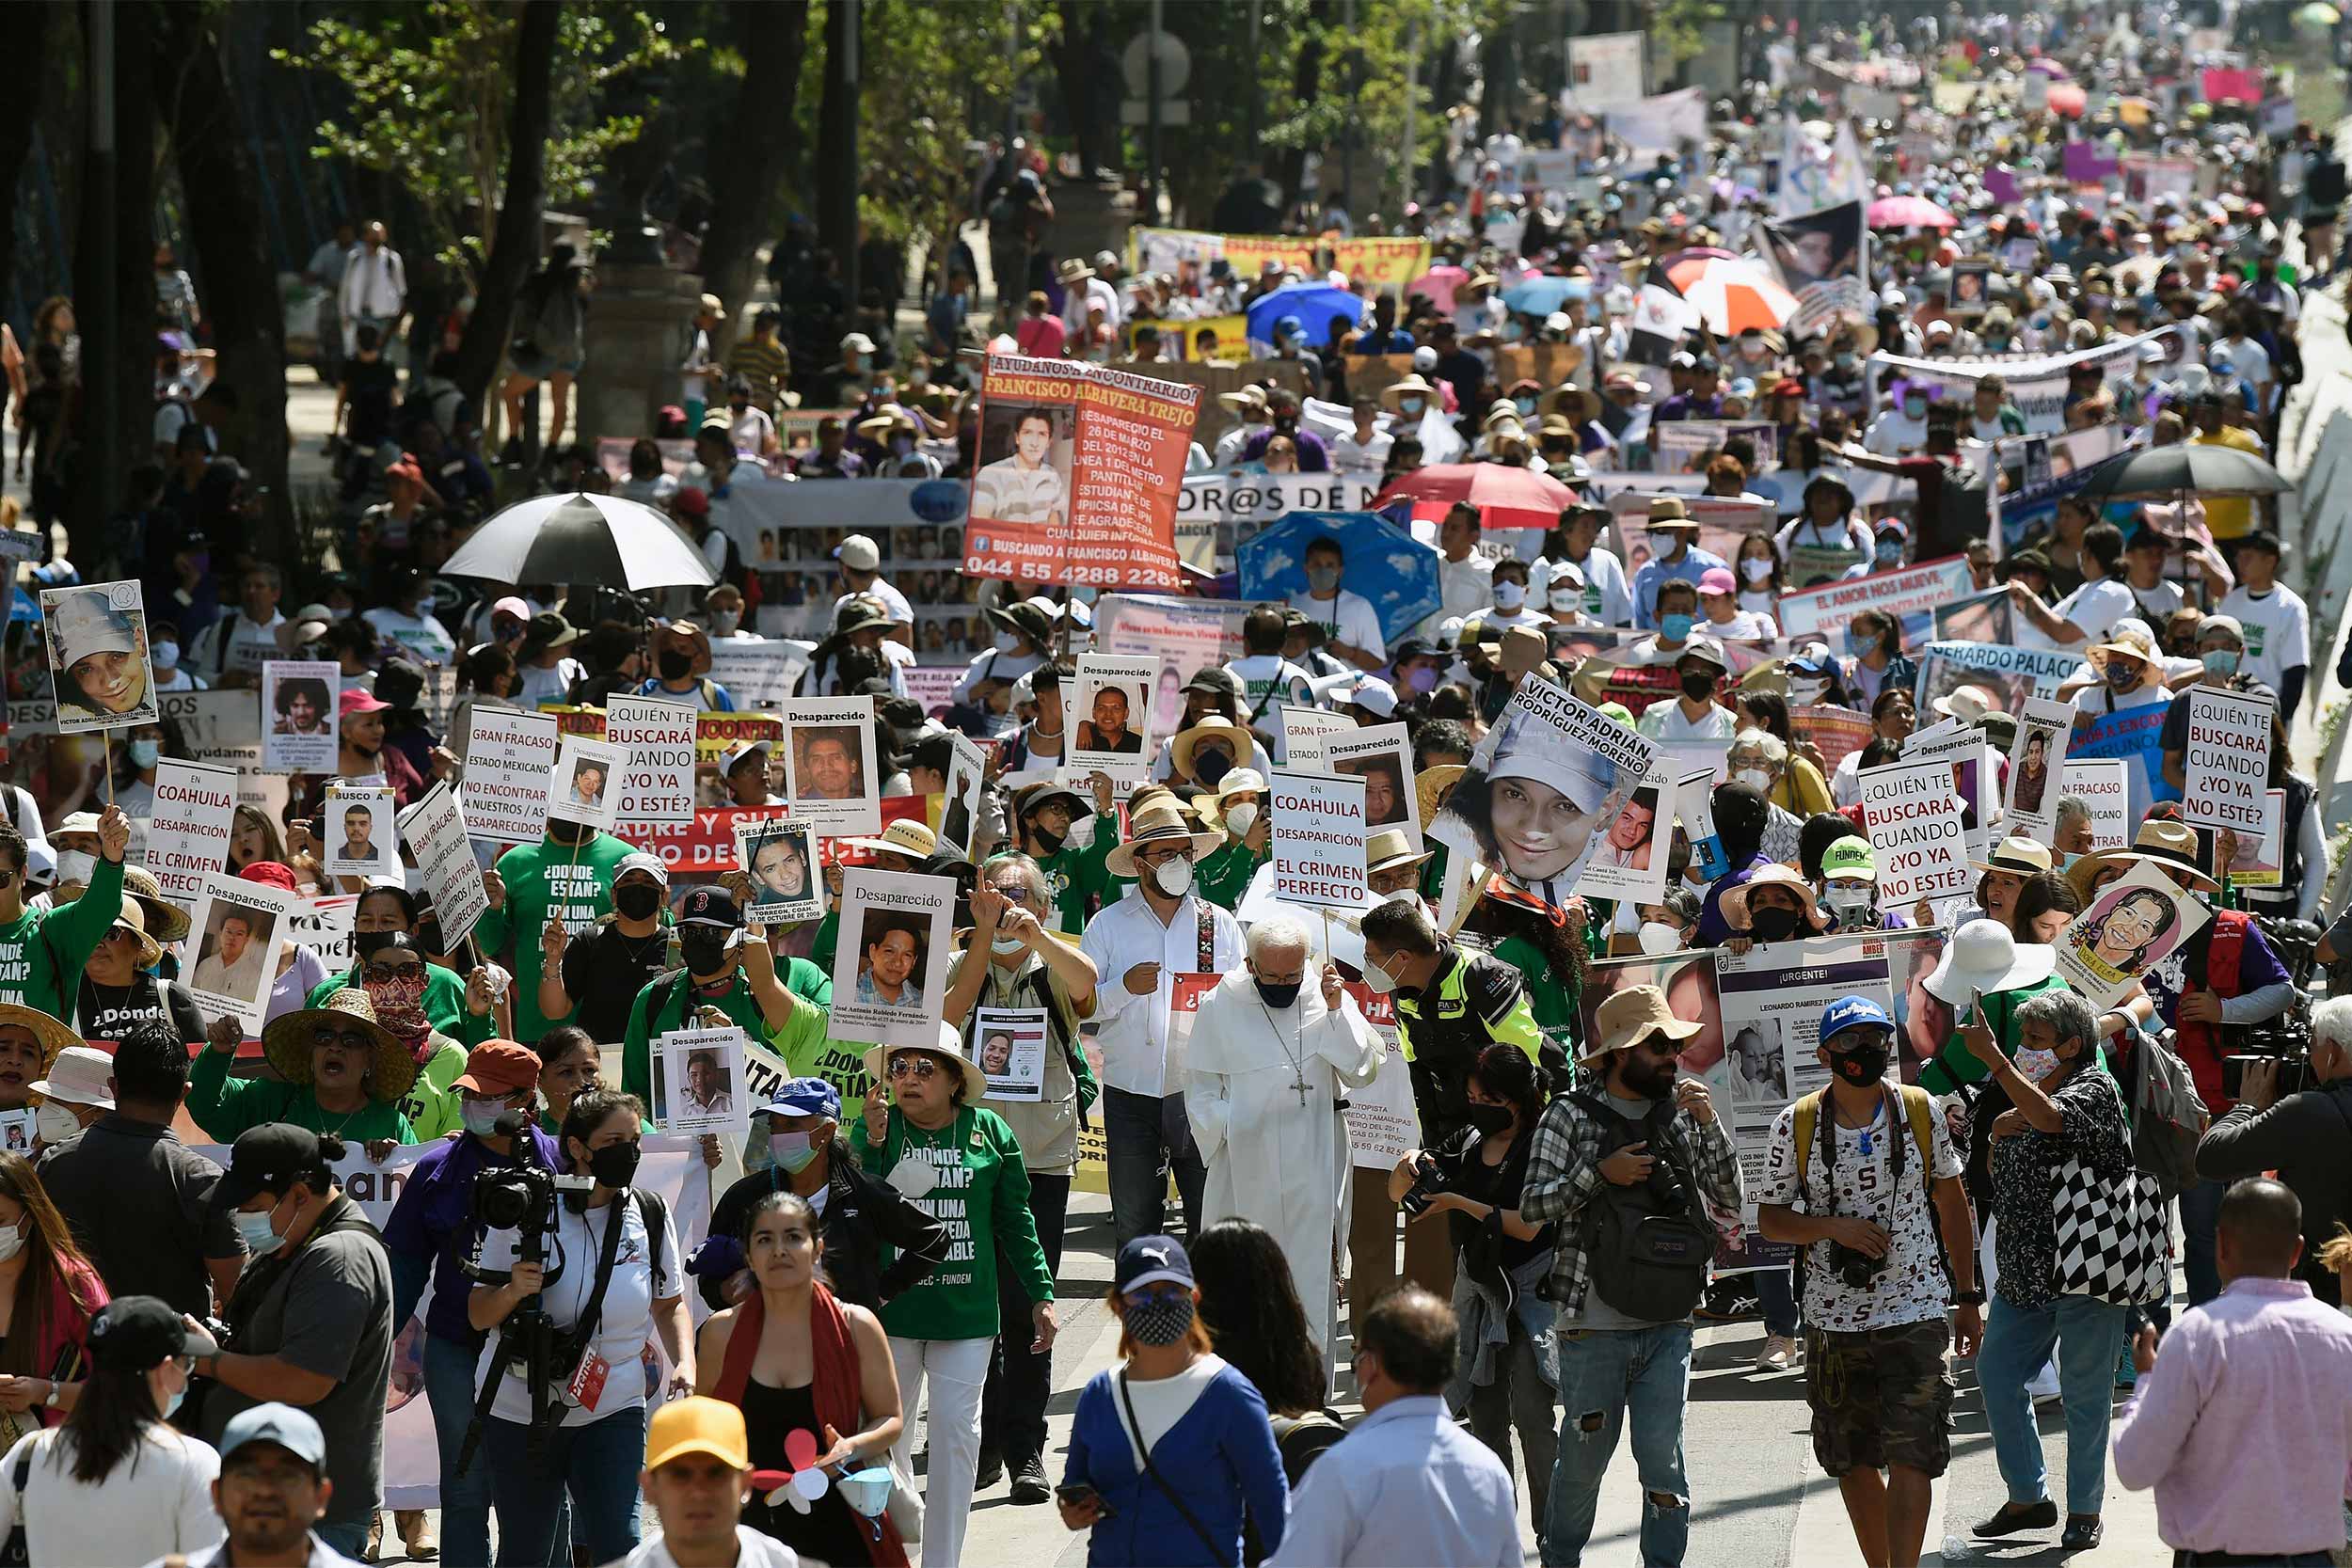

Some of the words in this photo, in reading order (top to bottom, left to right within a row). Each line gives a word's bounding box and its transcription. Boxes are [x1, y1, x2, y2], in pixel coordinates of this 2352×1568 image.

[984, 377, 1071, 398] FRANCISCO
[1074, 384, 1145, 414] ALBAVERA
[1149, 401, 1195, 427] TREJO
[1088, 426, 1101, 436] 26
[1104, 430, 1117, 441] DE
[1151, 430, 1165, 440] EL
[1083, 439, 1102, 451] DEL
[1105, 443, 1128, 455] 2012
[1129, 451, 1139, 462] EN
[1141, 455, 1152, 467] LA
[1106, 455, 1111, 467] 1
[1131, 467, 1163, 486] METRO
[1140, 498, 1152, 510] DE
[993, 540, 1053, 557] BUSCANDO
[1057, 547, 1063, 558] A
[1066, 546, 1126, 560] FRANCISCO
[1130, 550, 1178, 570] ALBAVERA
[967, 557, 1012, 576] 044
[1021, 563, 1051, 579] 55
[1059, 565, 1120, 584] 4288
[1871, 579, 1897, 595] NOS
[1083, 667, 1152, 676] Desaparecido
[60, 718, 80, 726] VICTOR
[609, 707, 670, 722] ¿QUIÉN
[676, 712, 694, 723] TE
[789, 712, 865, 721] Desaparecido
[1526, 680, 1589, 723] VICTOR
[1587, 715, 1652, 759] ADRIÁN
[2024, 713, 2067, 729] Desaparecido
[2192, 704, 2248, 725] ¿QUIÉN
[2252, 713, 2269, 730] TE
[473, 729, 502, 742] GRAN
[505, 733, 552, 749] FRACASO
[609, 727, 692, 743] BUSCARÁ
[1287, 726, 1314, 736] GRAN
[1515, 693, 1591, 741] RODRÍGUEZ
[1587, 736, 1645, 774] MORENO
[2191, 726, 2267, 754] BUSCARÁ
[573, 746, 616, 761] Desaparecido
[1329, 737, 1401, 754] Desaparecido
[1921, 735, 1982, 755] Desaparecido
[955, 743, 981, 771] Desaparecido
[1289, 751, 1318, 759] ESTADO
[2190, 749, 2265, 778] CUANDO
[469, 756, 501, 768] ESTADO
[502, 761, 549, 774] MEXICANO
[191, 775, 200, 784] EN
[657, 773, 678, 788] YA
[1865, 775, 1927, 803] ¿QUIÉN
[1931, 773, 1952, 790] TE
[2073, 783, 2121, 795] FRACASO
[2200, 776, 2231, 794] ¿YO
[2235, 781, 2253, 800] YA
[157, 784, 231, 809] COAHUILA
[465, 782, 481, 792] NO
[484, 783, 547, 800] ENCONTRAR
[1310, 785, 1321, 794] EN
[463, 799, 470, 807] A
[472, 800, 522, 815] NUESTROS
[532, 806, 545, 817] AS
[641, 794, 691, 812] ESTÉ?
[1275, 795, 1360, 818] COAHUILA
[1867, 793, 1956, 827] BUSCARÁ
[2186, 798, 2214, 816] NO
[2219, 802, 2263, 825] ESTÉ?
[184, 809, 192, 817] LA
[153, 818, 228, 838] DESAPARICIÓN
[413, 833, 430, 856] GRAN
[429, 805, 456, 834] FRACASO
[739, 823, 812, 836] DESAPARECIDO
[1277, 828, 1362, 847] DESAPARICIÓN
[1873, 820, 1959, 850] CUANDO
[147, 849, 161, 865] EL
[166, 852, 222, 873] CRIMEN
[423, 859, 438, 881] ESTADO
[438, 833, 466, 863] MEXICANO
[1836, 850, 1866, 861] FUNDEM
[1890, 851, 1922, 873] ¿YO
[1927, 847, 1952, 863] YA
[544, 865, 594, 880] ¿DONDE
[1277, 859, 1294, 873] EL
[1299, 861, 1363, 881] CRIMEN
[433, 895, 441, 908] NO
[441, 859, 476, 898] ENCONTRAR
[550, 880, 601, 897] ESTAN?
[1278, 879, 1363, 900] PERFECTO
[1882, 879, 1909, 899] NO
[1915, 867, 1967, 892] ESTÉ?
[207, 884, 285, 912] Desaparecido
[439, 915, 445, 925] A
[443, 888, 468, 918] NUESTROS
[472, 875, 482, 892] AS
[855, 887, 943, 908] Desaparecido
[443, 894, 485, 943] DESAPARECIDOS
[572, 905, 596, 919] UNA
[1862, 944, 1884, 955] AMBER
[2078, 948, 2095, 967] DORA
[1779, 969, 1828, 984] ¡URGENTE!
[873, 1008, 898, 1017] Robledo
[898, 1010, 929, 1019] Fernández
[1759, 1002, 1795, 1012] LEONARDO
[1795, 1000, 1822, 1009] RAMIREZ
[672, 1035, 734, 1046] Desaparecido
[1386, 1147, 1395, 1155] 82
[1769, 1147, 1784, 1168] S
[1858, 1165, 1877, 1192] S
[938, 1199, 966, 1217] UNA
[942, 1273, 972, 1285] FUNDEM
[570, 1351, 595, 1401] Prensa
